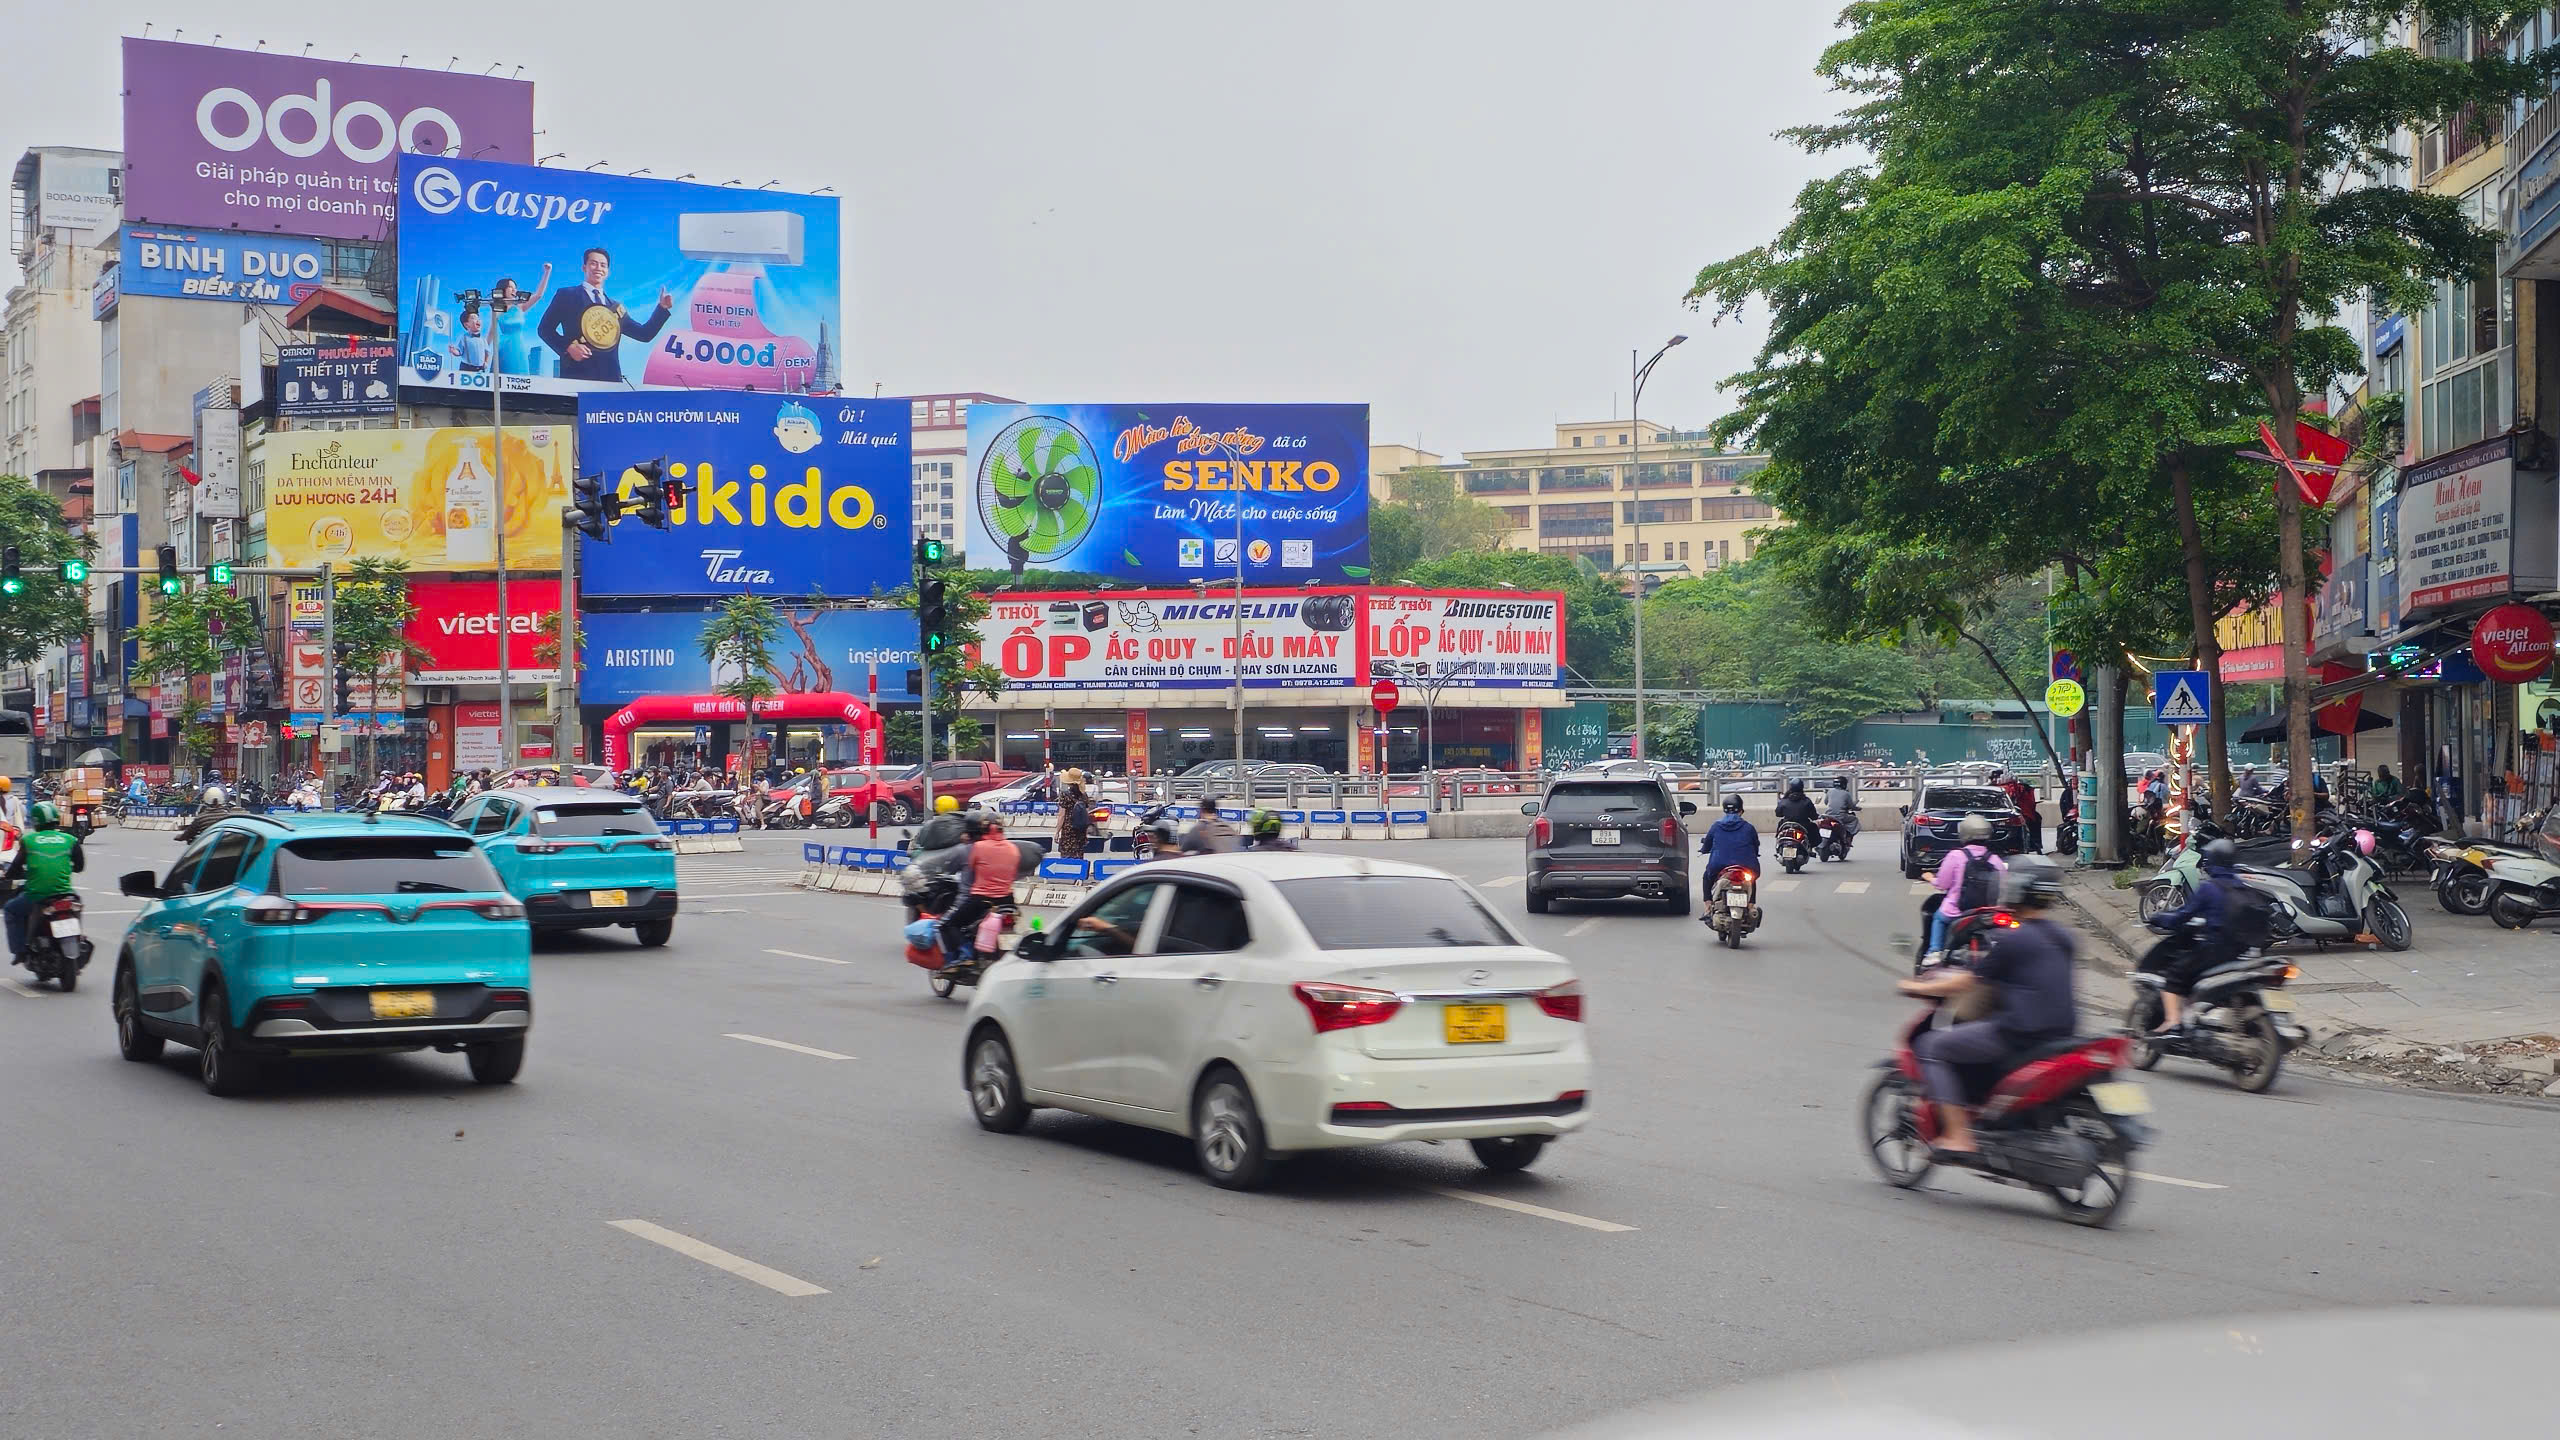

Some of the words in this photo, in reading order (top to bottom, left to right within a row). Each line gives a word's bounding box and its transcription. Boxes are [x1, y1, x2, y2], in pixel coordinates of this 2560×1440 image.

[196, 78, 462, 164] odoo
[196, 161, 235, 181] Giải
[240, 166, 290, 188] pháp
[295, 170, 342, 191] quản
[348, 175, 369, 195] trị
[224, 190, 261, 207] cho
[266, 194, 302, 213] mọi
[307, 198, 367, 217] doanh
[466, 179, 613, 230] Casper
[369, 346, 395, 358] HOA
[296, 360, 333, 378] THIẾT
[335, 363, 348, 378] BỊ
[350, 363, 359, 375] Y
[361, 358, 379, 375] TẾ
[627, 409, 653, 423] DÁN
[707, 411, 740, 425] LẠNH
[837, 430, 868, 445] Mát
[870, 432, 898, 448] quá
[1114, 423, 1169, 464] Mùa
[1170, 415, 1193, 438] hè
[1272, 435, 1289, 448] đã
[1292, 435, 1307, 448] có
[291, 450, 379, 471] Enchanteur
[277, 478, 294, 488] DA
[368, 475, 392, 488] MỊN
[1162, 460, 1341, 492] SENKO
[306, 492, 356, 505] HƯƠNG
[359, 488, 397, 504] 24H
[1154, 505, 1185, 520] Làm
[1189, 498, 1236, 522] Mát
[1241, 506, 1267, 519] cho
[1272, 506, 1303, 523] cuộc
[1305, 505, 1337, 523] sống
[66, 561, 81, 580] 16
[213, 566, 227, 582] 16
[699, 549, 771, 584] Tatra
[997, 602, 1040, 620] THỜI
[1162, 602, 1299, 621] MICHELIN
[1443, 599, 1554, 620] BRIDGESTONE
[1148, 638, 1197, 663] QUY
[1223, 629, 1274, 659] DẦU
[1282, 629, 1340, 658] MÁY
[1371, 614, 1431, 658] LỐP
[1458, 629, 1484, 655] QUY
[1496, 622, 1520, 654] DẦU
[1524, 626, 1553, 655] MÁY
[605, 648, 675, 667] ARISTINO
[1169, 663, 1185, 678] ĐỘ
[1188, 665, 1222, 678] CHỤM
[1293, 663, 1338, 674] LAZANG
[1530, 663, 1552, 676] LAZANG
